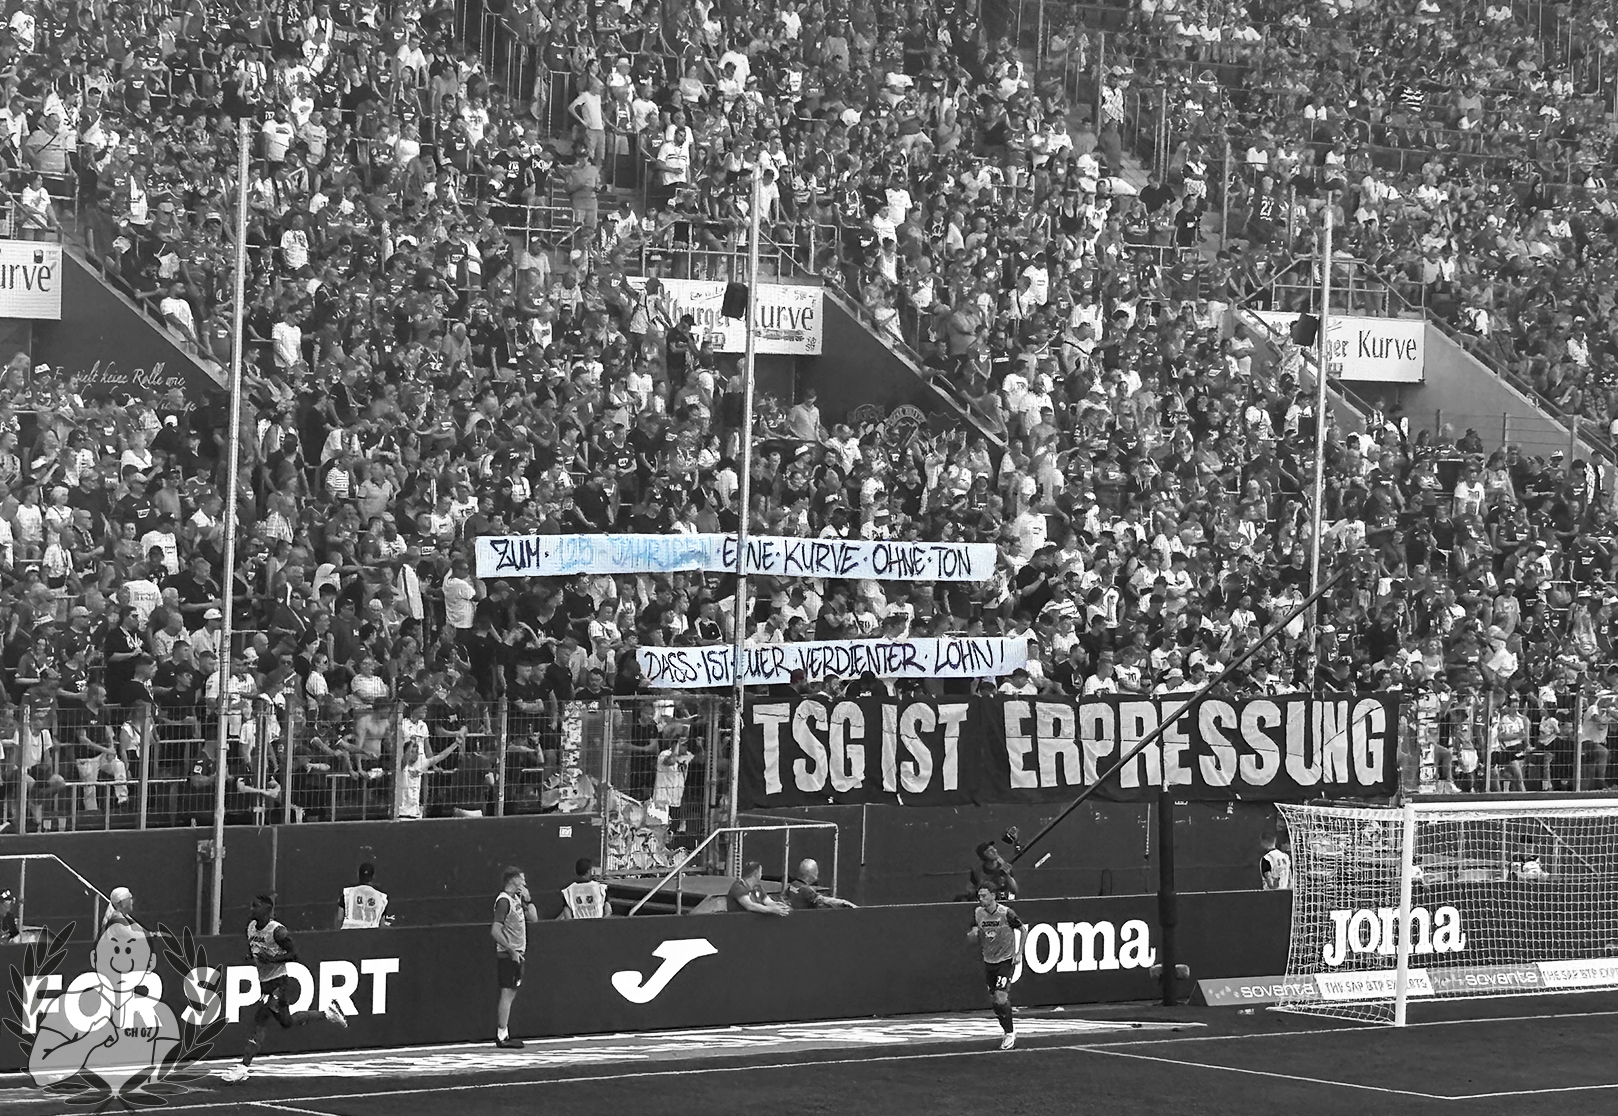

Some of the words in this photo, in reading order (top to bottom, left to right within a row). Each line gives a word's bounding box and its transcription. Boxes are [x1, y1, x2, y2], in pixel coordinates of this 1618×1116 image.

[754, 298, 814, 331] urve
[1358, 330, 1417, 361] Kurve
[132, 362, 166, 390] Rolle
[490, 537, 540, 571] ZUM
[722, 536, 775, 571] ENE
[784, 540, 861, 575] KURVE
[872, 543, 926, 577] OHNE
[930, 546, 972, 577] TON
[644, 651, 698, 684] DASS
[701, 649, 731, 684] IST
[741, 646, 791, 680] UER
[798, 641, 926, 678] VERDIENTER
[753, 701, 866, 795] TSG
[881, 701, 969, 795] IST
[1002, 699, 1386, 790] ERPRESSUNG
[1240, 982, 1315, 999] sovanta
[1464, 969, 1538, 986] sovanta
[21, 970, 163, 1035] FOR
[181, 958, 400, 1025] SPORT
